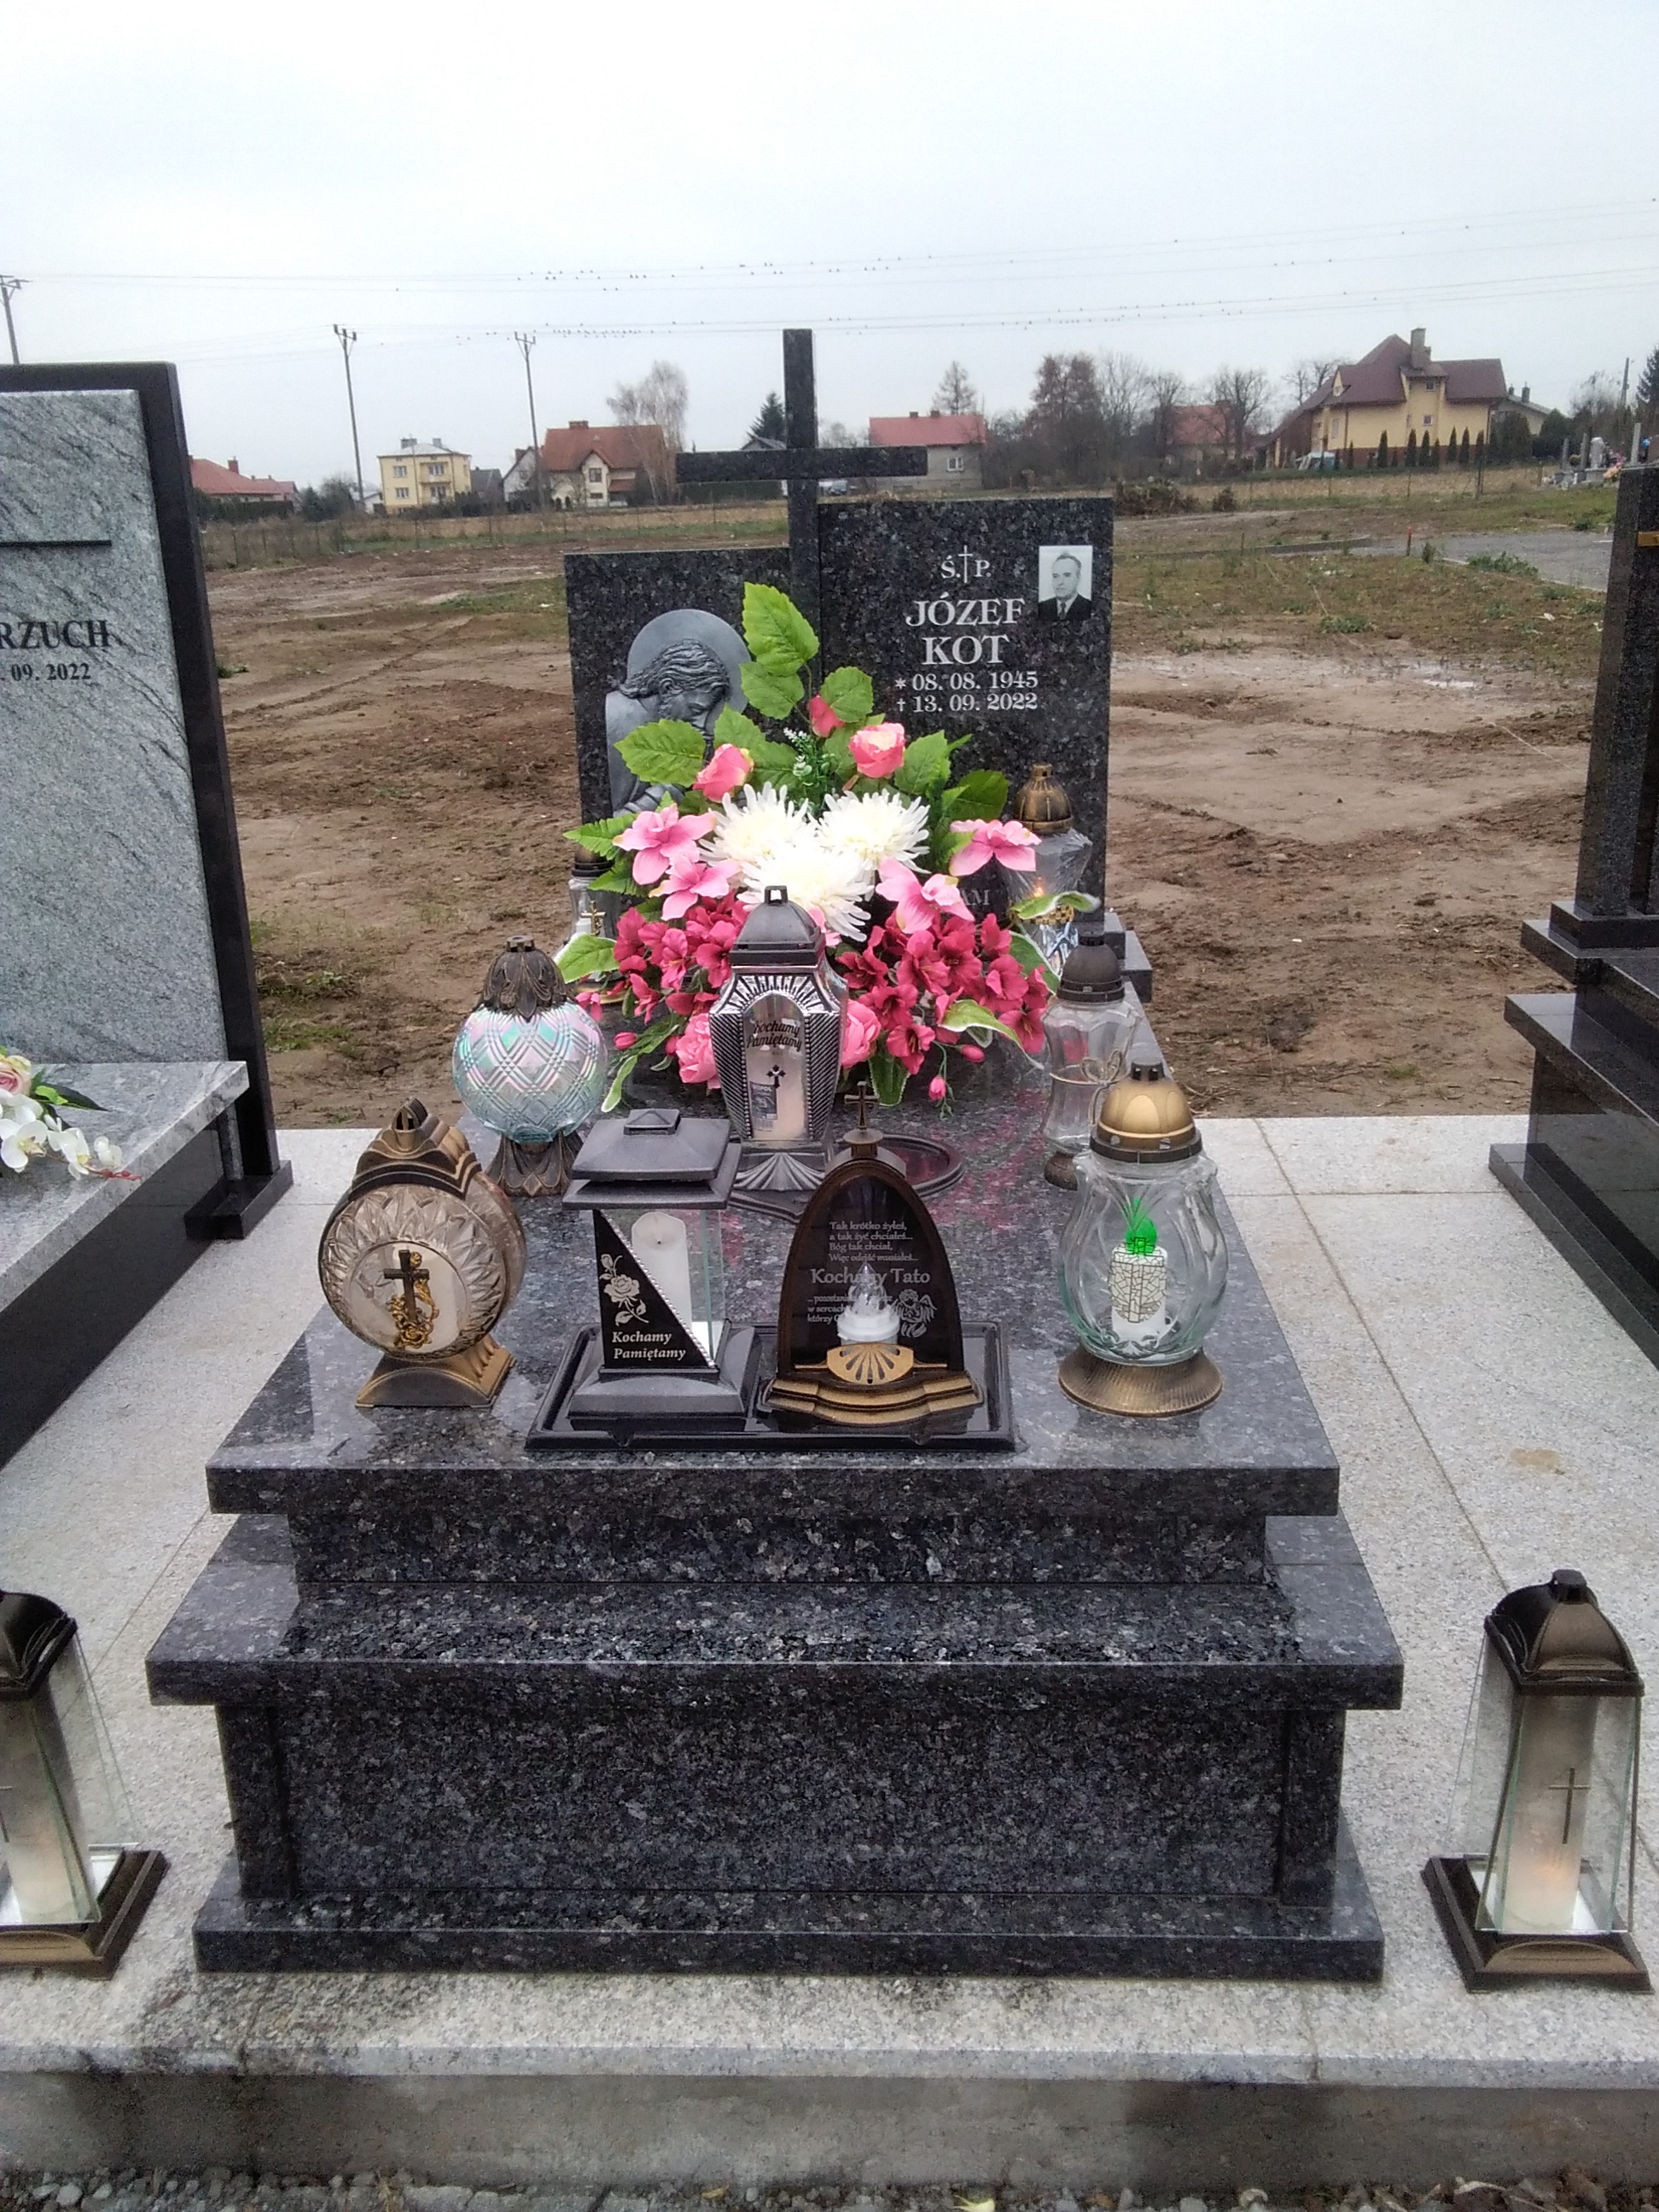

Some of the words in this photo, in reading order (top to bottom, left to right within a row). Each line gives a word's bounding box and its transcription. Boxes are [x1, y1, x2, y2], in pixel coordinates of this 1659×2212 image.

[905, 591, 1026, 626] JÓZEF
[922, 634, 1010, 666] KOT
[46, 663, 91, 681] 2022
[991, 670, 1039, 689] 1945
[987, 692, 1039, 711] 2022
[754, 1020, 800, 1037] Kochamy
[747, 1033, 802, 1052] Pamiętamy
[830, 1220, 848, 1231] Tak
[850, 1220, 881, 1231] krótko
[837, 1231, 853, 1241] tak
[829, 1243, 847, 1253] Bóg
[848, 1242, 864, 1250] tak
[890, 1268, 931, 1284] Tato
[612, 1330, 672, 1345] Kochamy
[614, 1348, 686, 1361] Pamiętamy
